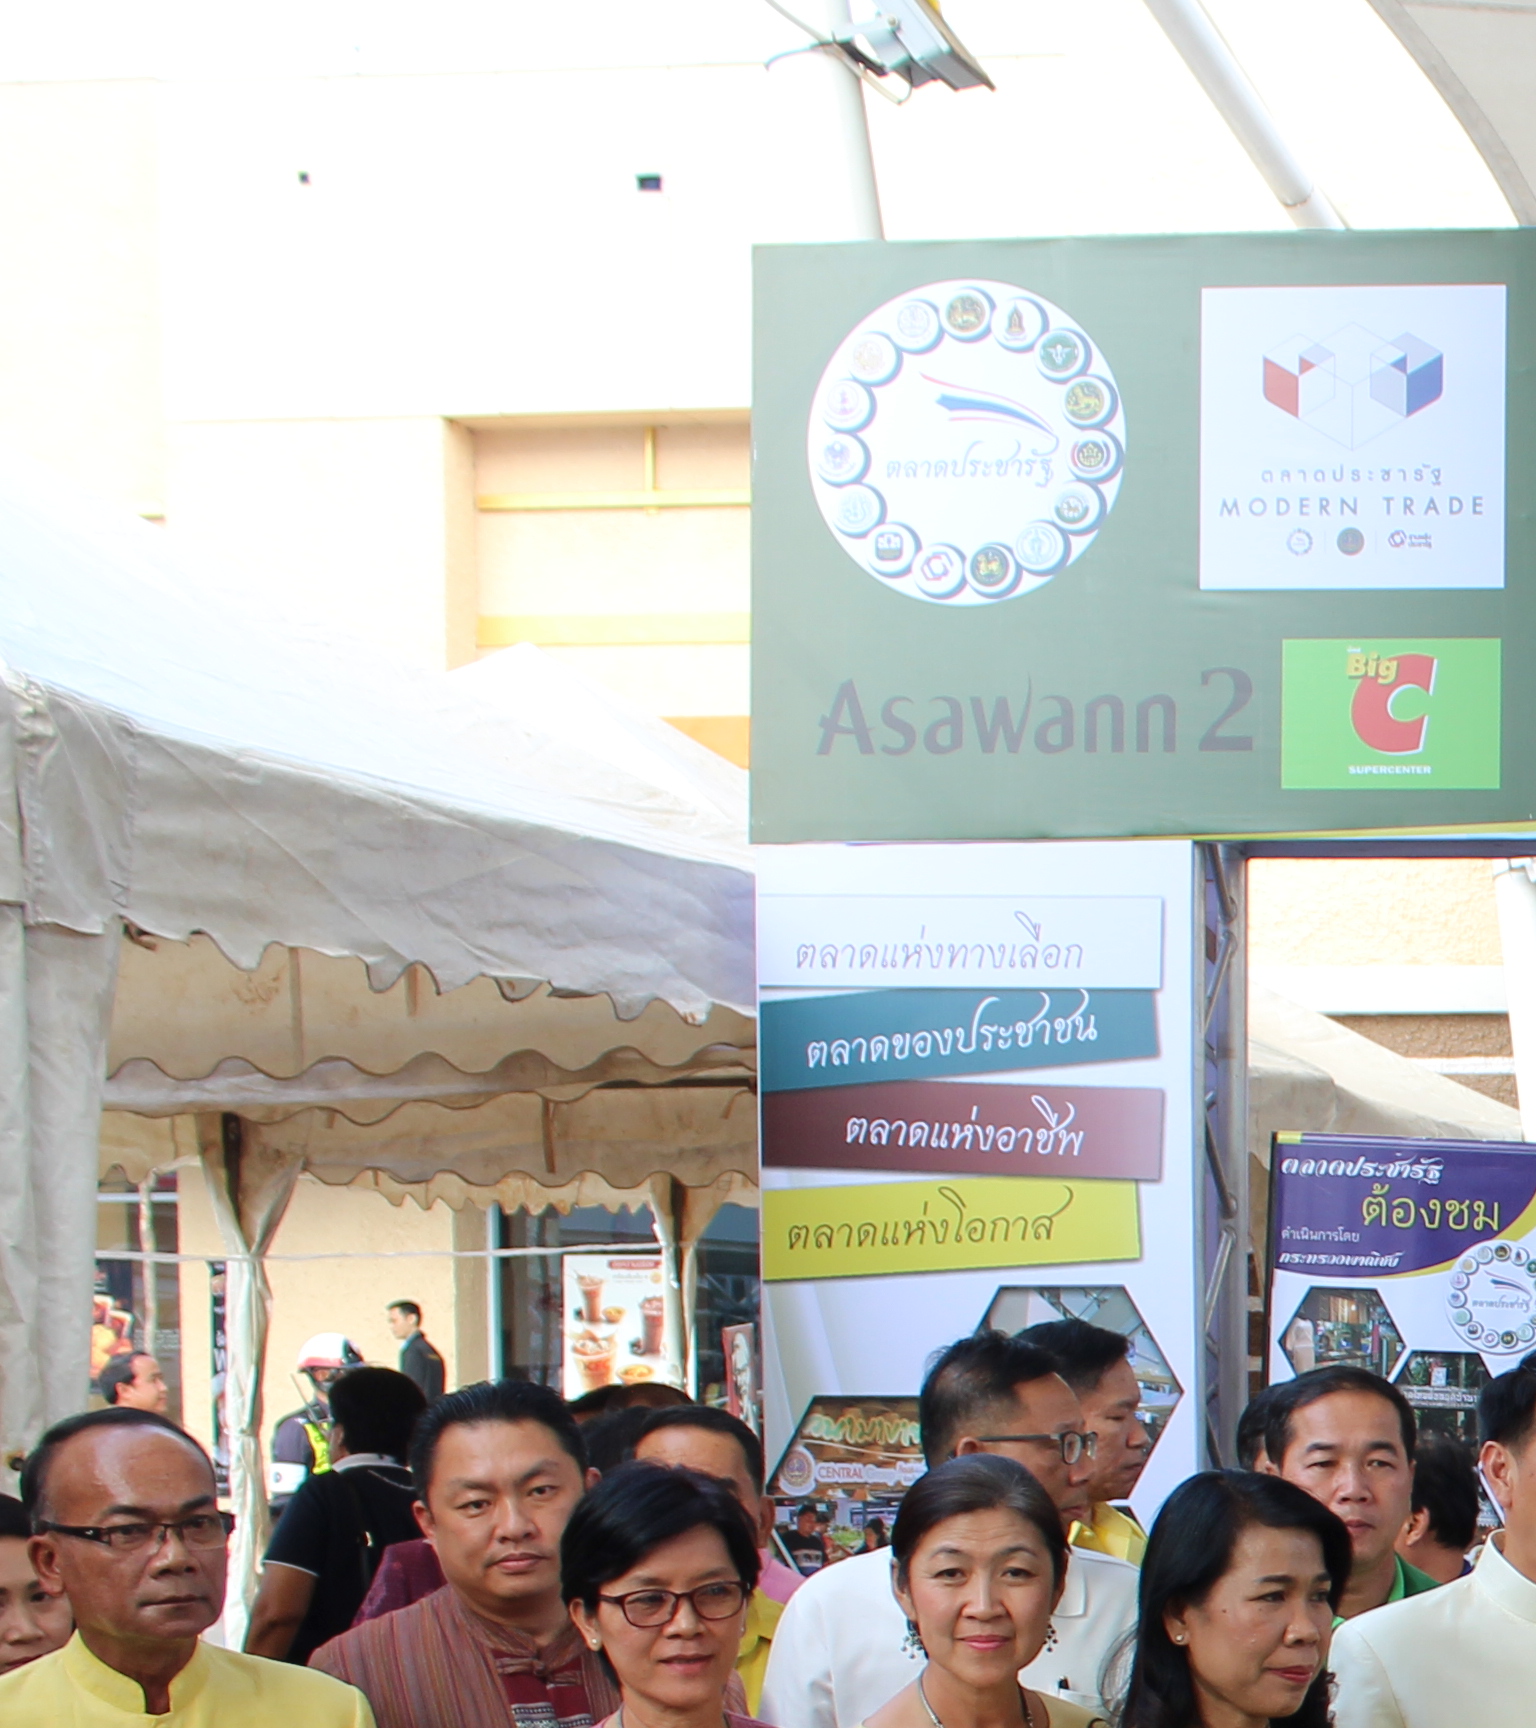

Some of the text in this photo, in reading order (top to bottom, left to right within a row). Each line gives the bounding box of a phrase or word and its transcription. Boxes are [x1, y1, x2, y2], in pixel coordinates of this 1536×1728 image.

[886, 436, 1060, 488] ตลาดประชารัฐ
[1261, 463, 1442, 486] ตลาดประชารัฐ
[1219, 495, 1484, 517] MODERN TRADE
[816, 666, 1254, 756] Asawann 2
[1346, 652, 1437, 756] Big C
[1348, 764, 1432, 776] SUPERCENTER
[796, 910, 1084, 969] ตลาดแห่งทางเลือก
[806, 988, 1099, 1068] ตลาดของประชาชน
[846, 1095, 1085, 1156] ตลาดแห่งอาชีพ
[788, 1185, 1074, 1250] ตลาดแห่งโอกาส
[1362, 1182, 1499, 1232] ต้องชม
[1281, 1226, 1361, 1243] ดำเนินการโดย
[818, 1466, 864, 1479] CENTRAL
